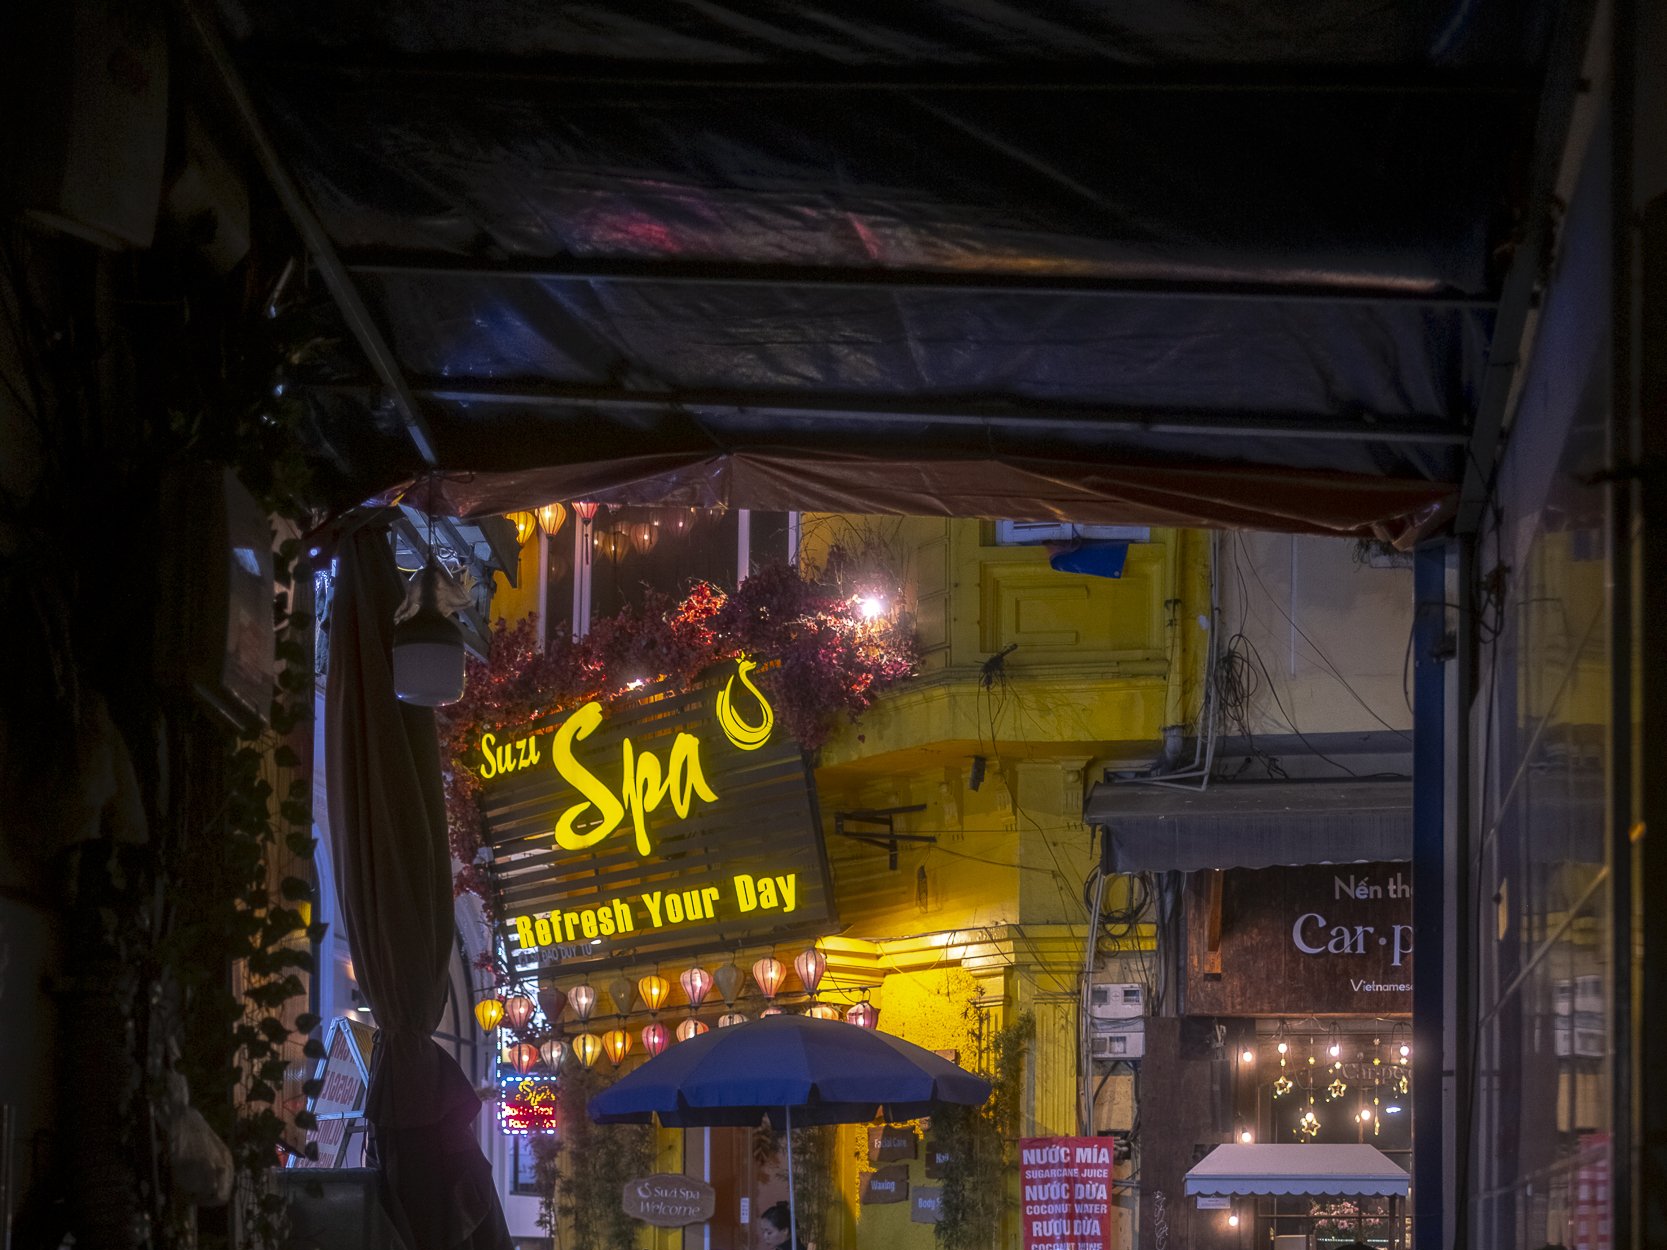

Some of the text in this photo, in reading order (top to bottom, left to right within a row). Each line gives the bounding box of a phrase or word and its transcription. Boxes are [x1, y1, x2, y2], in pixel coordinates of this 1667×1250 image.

[480, 701, 719, 857] Suzi Spa
[1334, 872, 1413, 900] Nến th
[516, 873, 797, 949] Refresh Your Day
[1023, 1144, 1110, 1165] NƯỚC MÍA
[1025, 1168, 1108, 1179] SUGARCANE JUICE
[679, 1188, 700, 1201] Spa
[1025, 1181, 1070, 1201] NƯỚC
[640, 1201, 700, 1217] Welcome
[1026, 1203, 1107, 1215] COCONUT WATER
